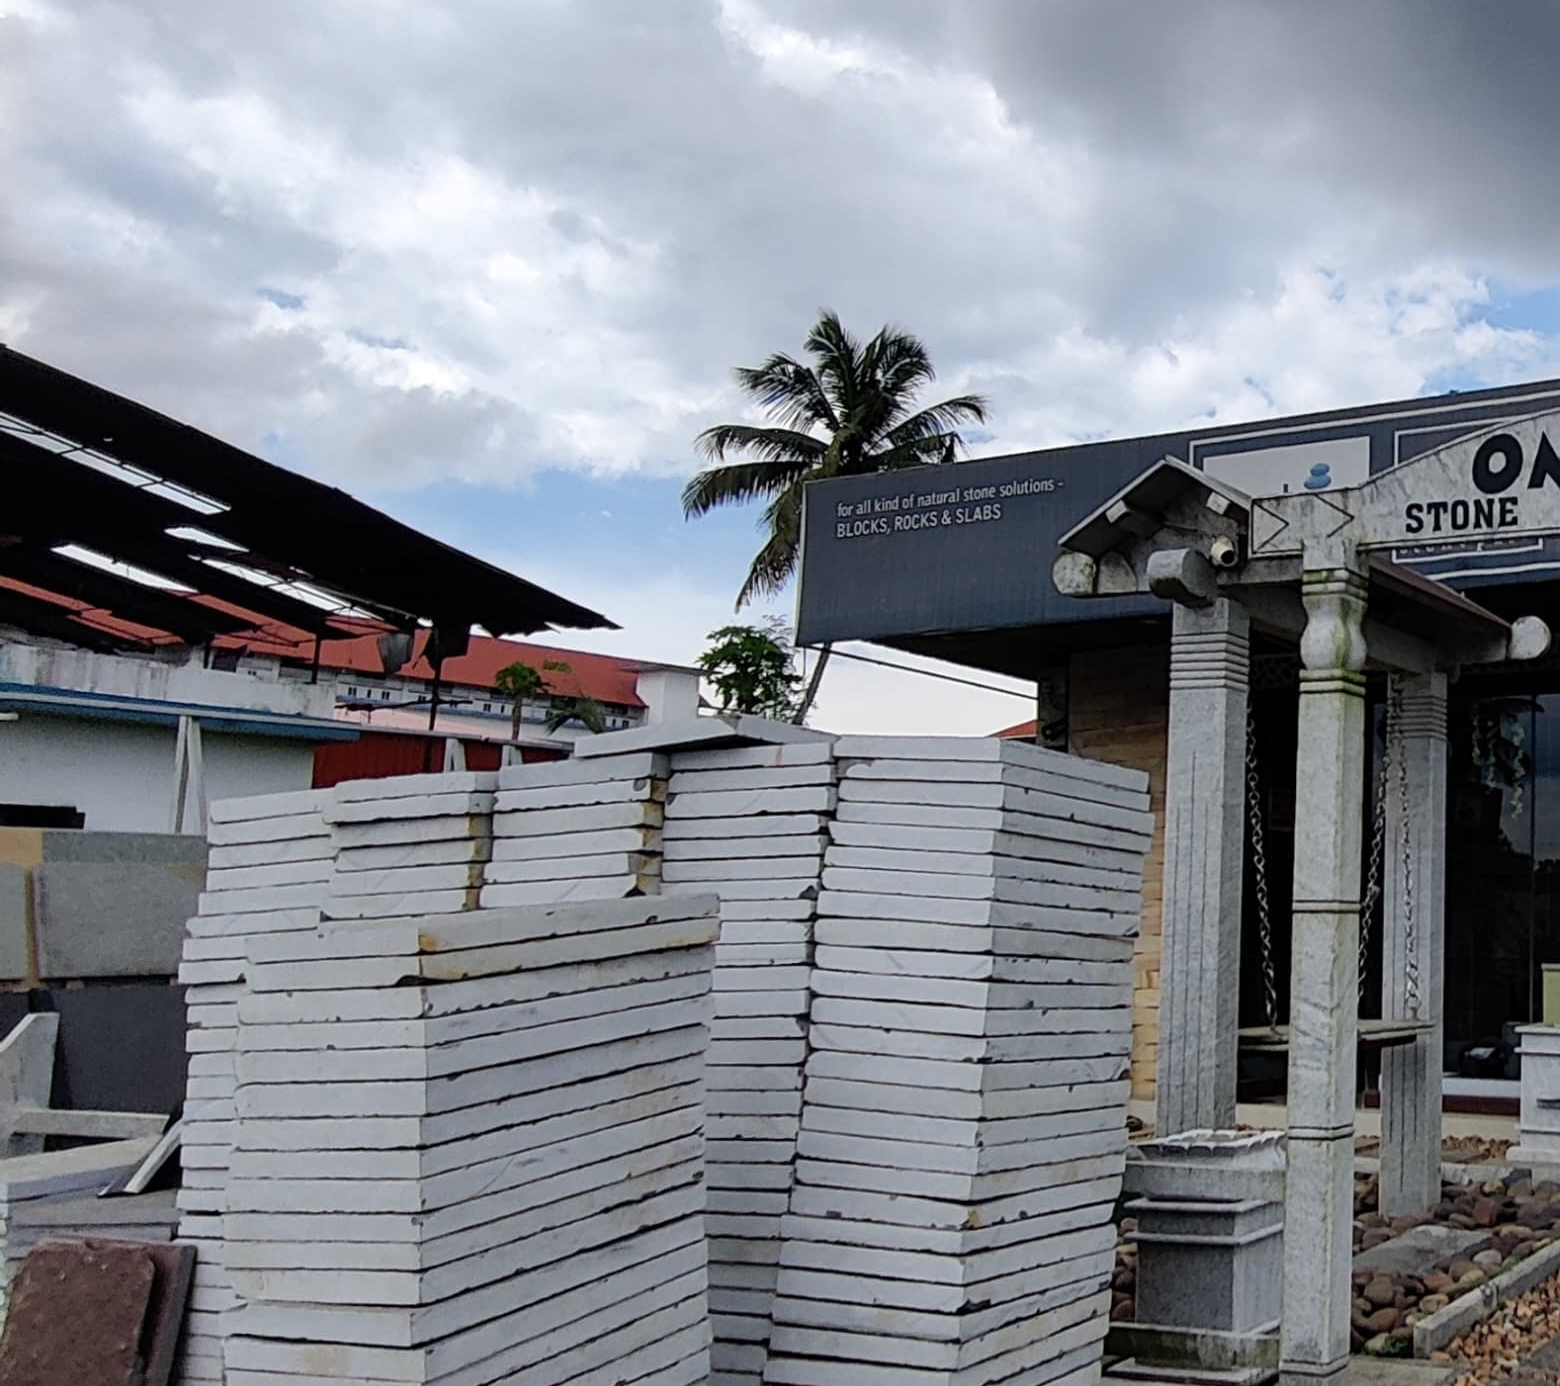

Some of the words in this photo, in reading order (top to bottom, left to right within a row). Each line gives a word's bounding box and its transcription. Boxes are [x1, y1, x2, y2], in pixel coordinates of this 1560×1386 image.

[837, 502, 853, 518] for
[856, 499, 871, 515] all
[874, 496, 899, 513] kind
[902, 494, 915, 510] of
[917, 488, 960, 508] natural
[963, 485, 996, 502] stone
[999, 478, 1054, 498] solutions
[1405, 496, 1519, 534] STONE
[837, 517, 891, 539] BLOCKS,
[894, 511, 938, 532] ROCKS
[941, 512, 951, 526] &
[955, 503, 1001, 525] SLABS
